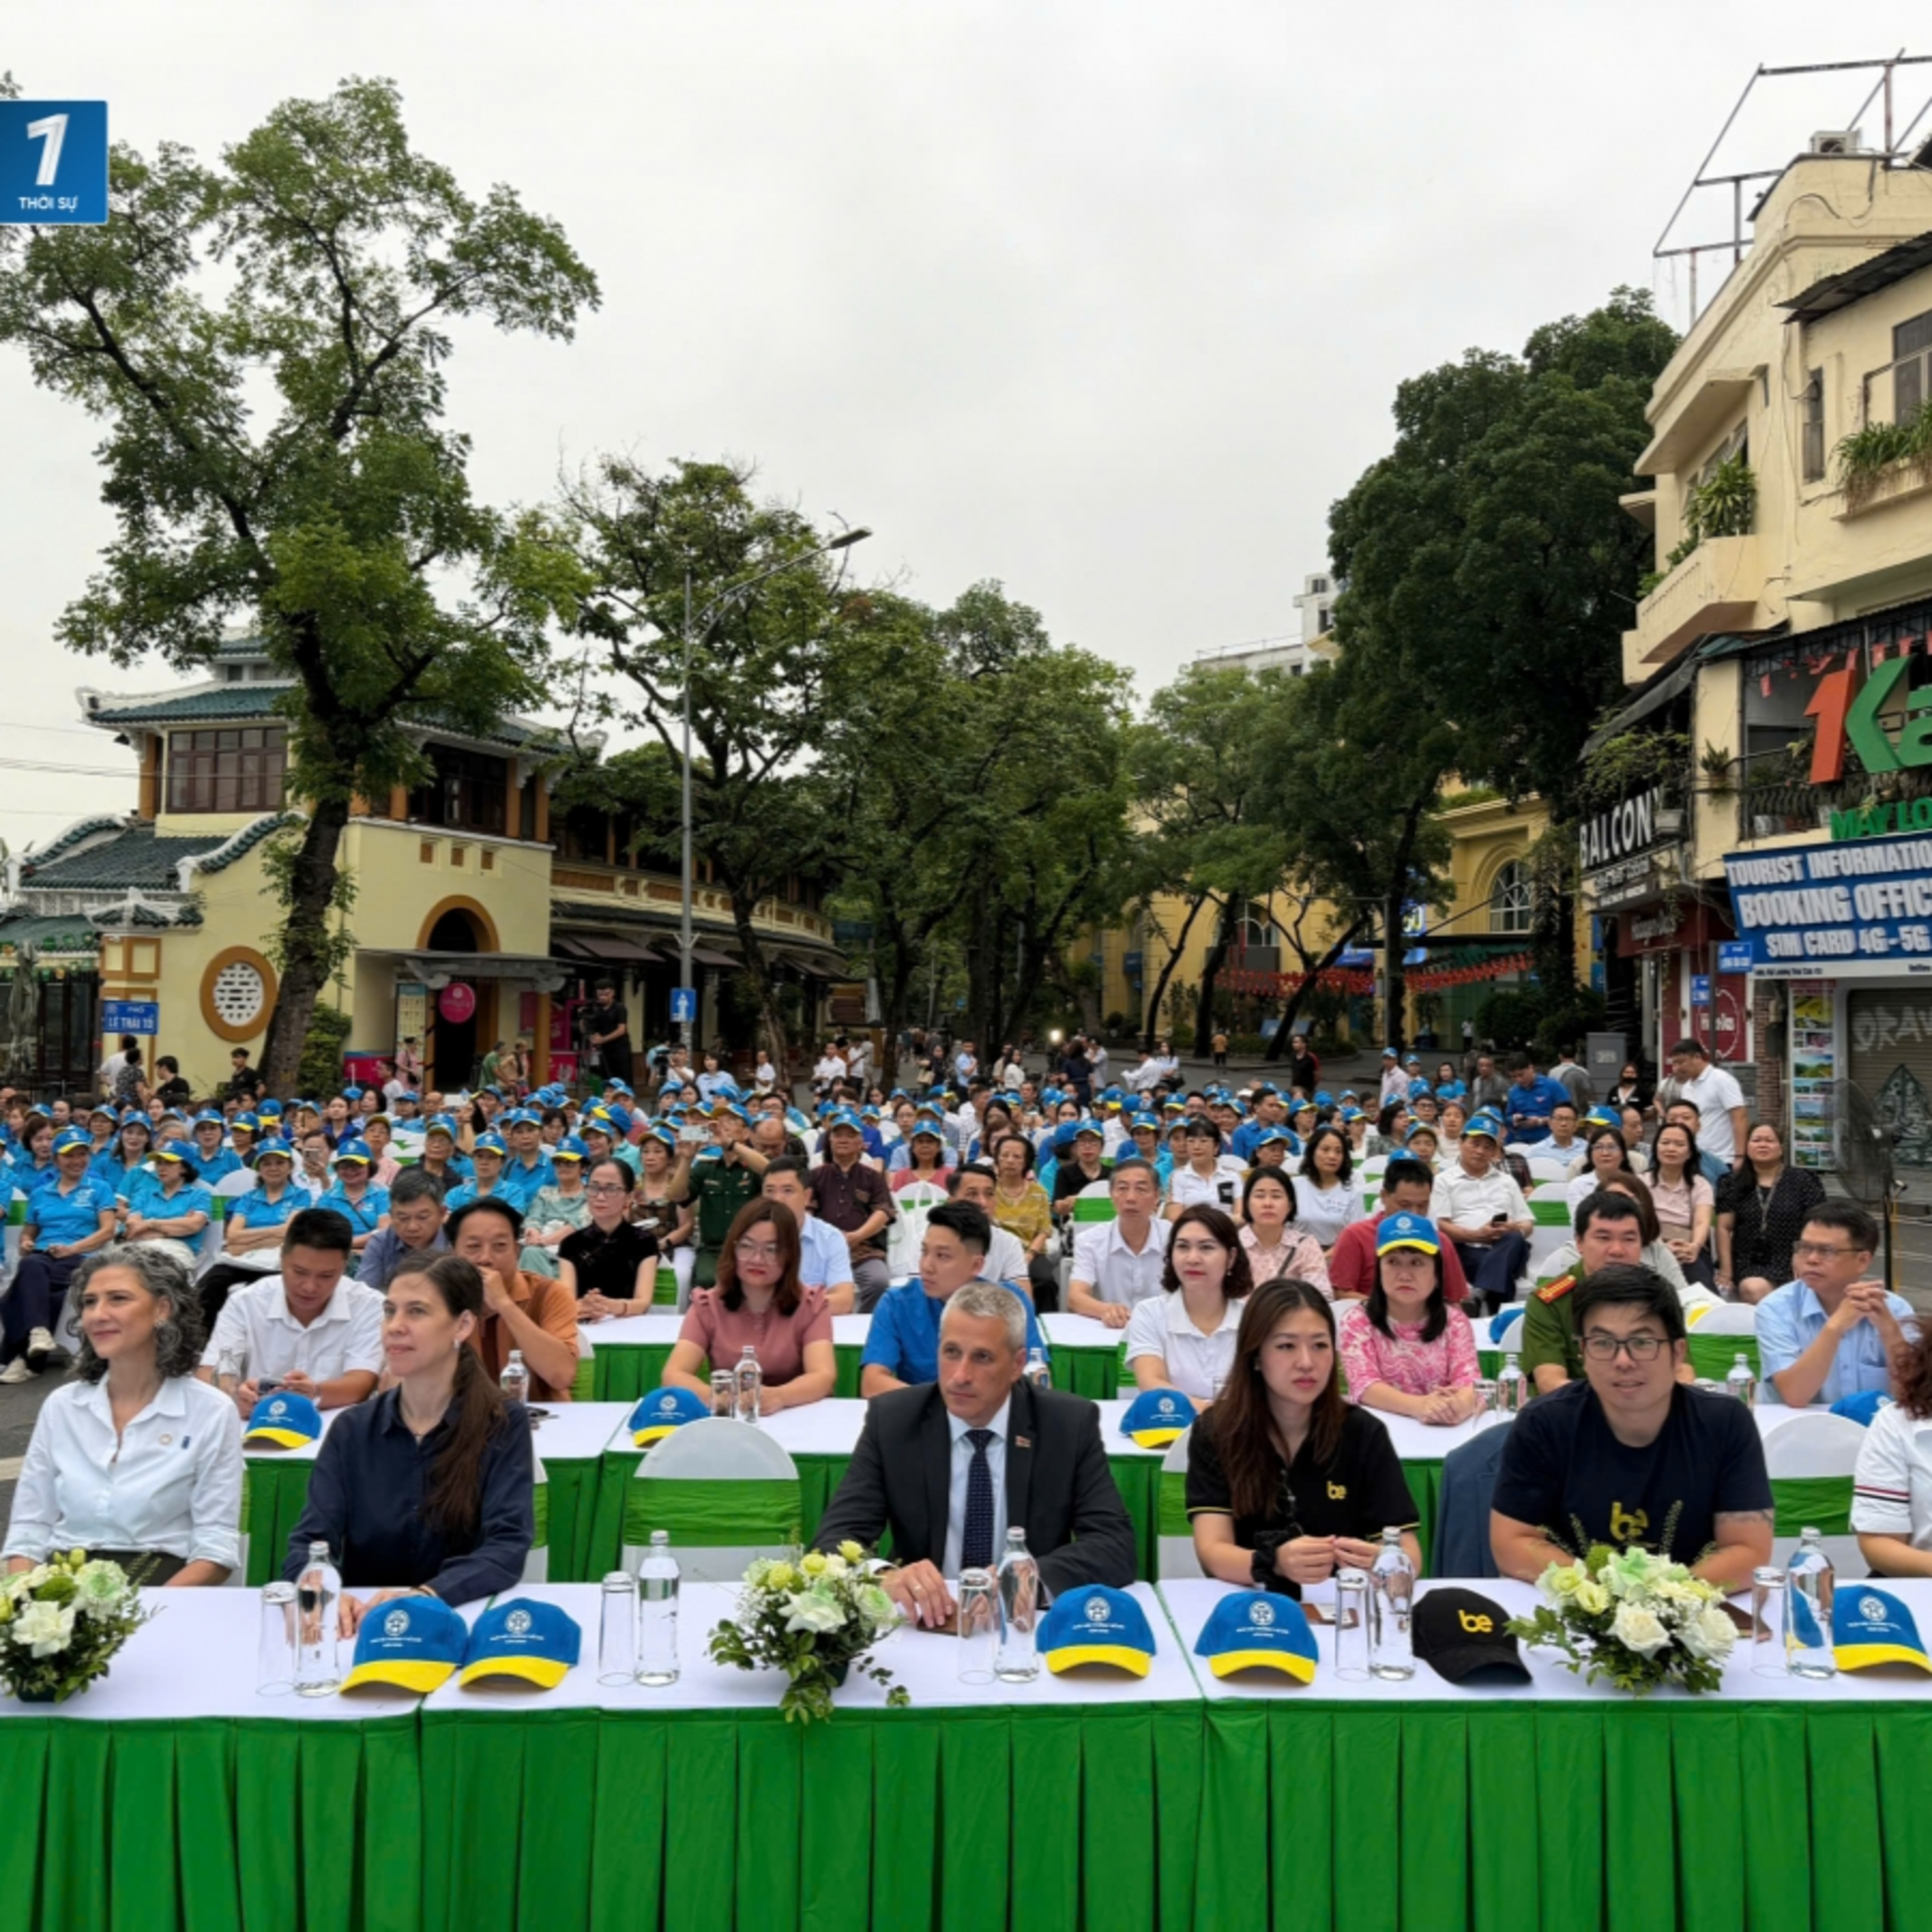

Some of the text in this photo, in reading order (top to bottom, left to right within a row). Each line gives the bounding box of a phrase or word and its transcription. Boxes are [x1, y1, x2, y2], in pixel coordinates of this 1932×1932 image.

[1580, 787, 1658, 868] BALCON
[1830, 804, 1890, 840] MAY
[1726, 856, 1804, 886] TOURIST
[1737, 886, 1853, 928] BOOKING
[1765, 932, 1803, 958] SIM
[1803, 929, 1857, 956] CARD
[1327, 1481, 1347, 1499] be
[1610, 1502, 1648, 1541] be
[1458, 1609, 1493, 1633] be
